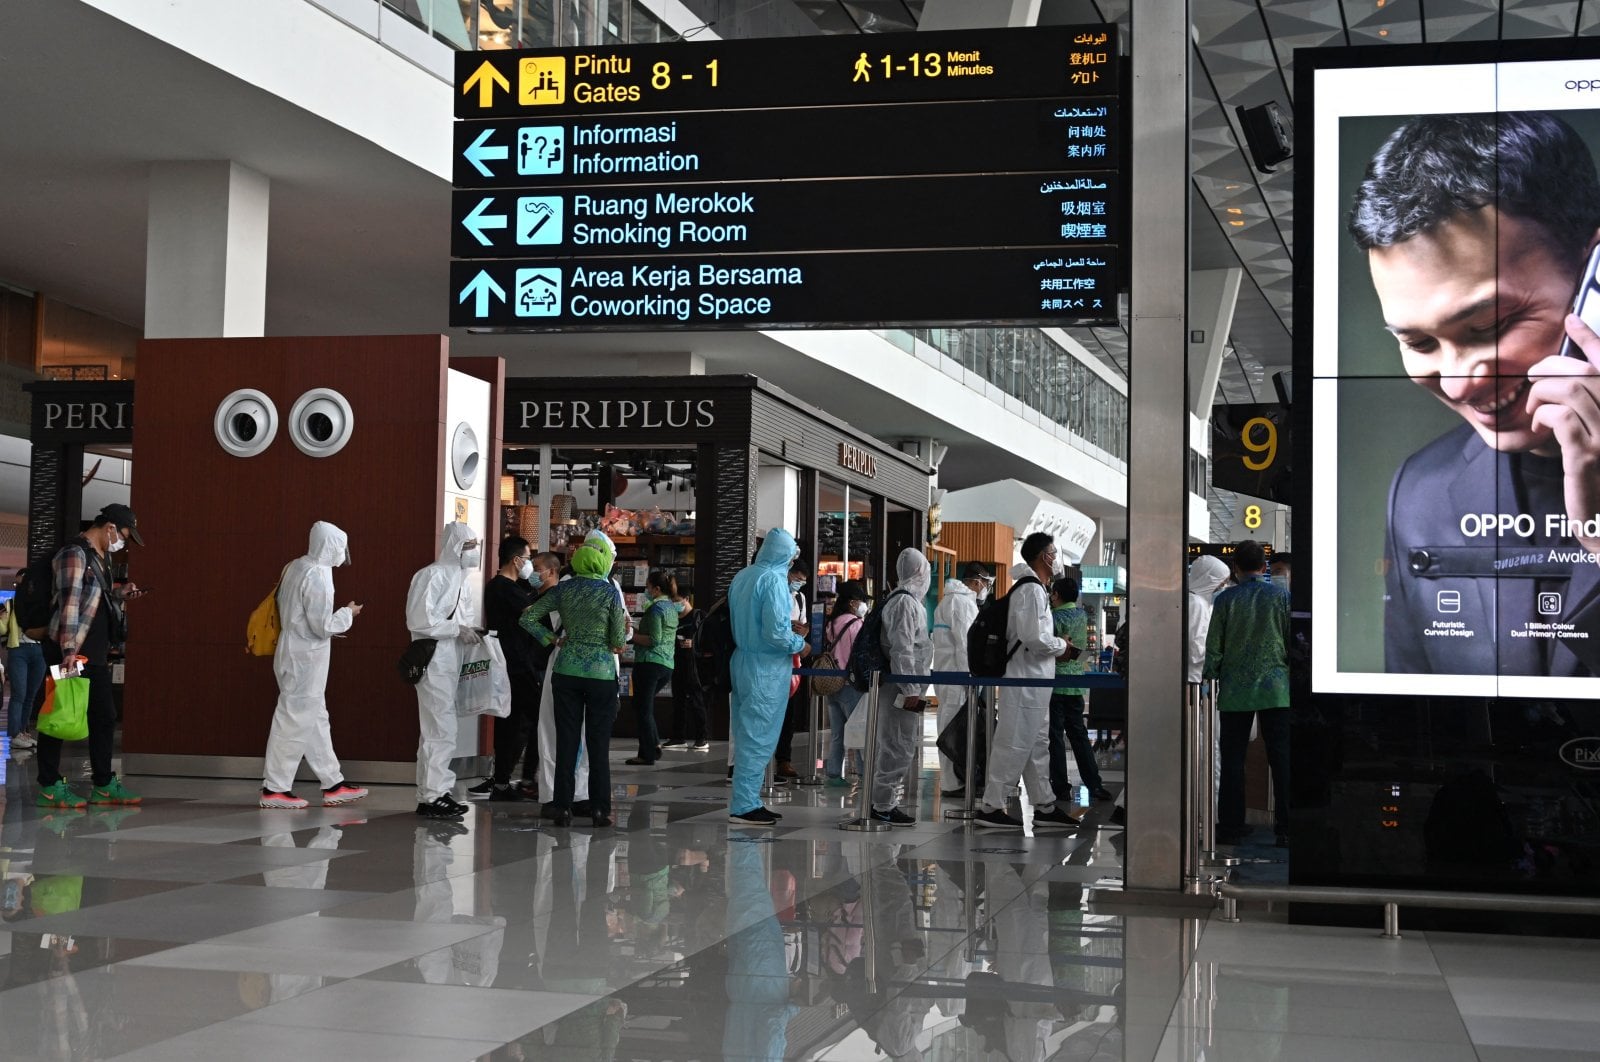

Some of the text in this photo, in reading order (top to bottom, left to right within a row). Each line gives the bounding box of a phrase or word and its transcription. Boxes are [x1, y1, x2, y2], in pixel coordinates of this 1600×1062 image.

[574, 54, 631, 76] Pintu
[880, 52, 942, 79] 1-13
[947, 50, 981, 63] Menit
[1069, 52, 1107, 66] 登机口
[651, 61, 671, 90] 8
[705, 58, 719, 87] 1
[947, 64, 994, 77] Minutes
[573, 82, 641, 104] Gates
[1564, 80, 1600, 92] opp
[573, 121, 677, 146] Informasi
[1068, 125, 1107, 139] 问询处
[1067, 143, 1107, 158] 案内所
[573, 151, 699, 175] Information
[574, 192, 755, 220] Ruang Merokok
[1061, 200, 1107, 216] 吸烟室
[572, 221, 747, 248] Smoking Room
[1061, 222, 1107, 239] 喫煙室
[570, 264, 803, 291] Area Kerja Bersama
[570, 292, 772, 320] Coworking Space
[43, 402, 134, 429] PERI
[519, 400, 715, 429] PERIPLUS
[1242, 417, 1278, 471] 9
[843, 442, 878, 479] PERIPLUS
[1244, 505, 1262, 529] 8
[1460, 513, 1600, 538] OPPO Find
[1432, 621, 1466, 629] Futuristic
[1450, 630, 1475, 638] Design
[1528, 630, 1556, 639] Primary
